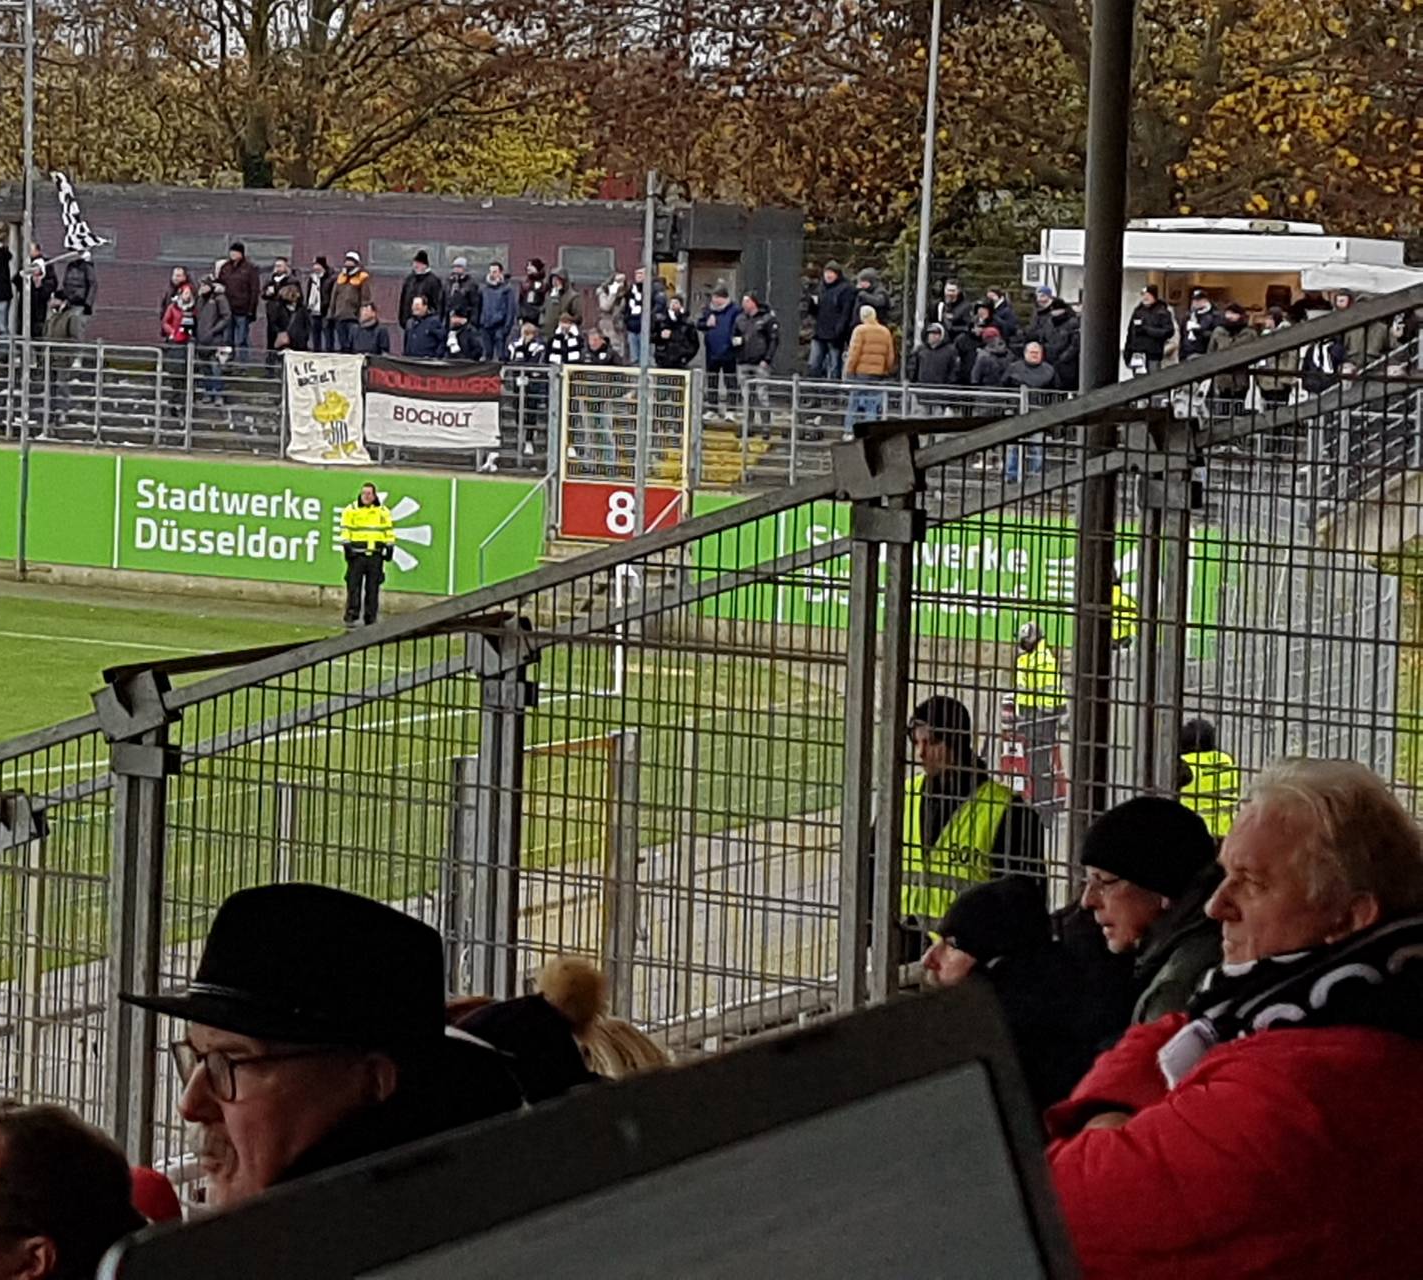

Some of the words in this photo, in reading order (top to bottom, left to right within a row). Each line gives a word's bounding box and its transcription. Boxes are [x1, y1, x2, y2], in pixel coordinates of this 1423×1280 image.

[393, 404, 473, 428] BOCHOLT
[136, 478, 322, 521] Stadtwerke
[606, 490, 637, 535] 8
[135, 516, 321, 563] Düsseldorf
